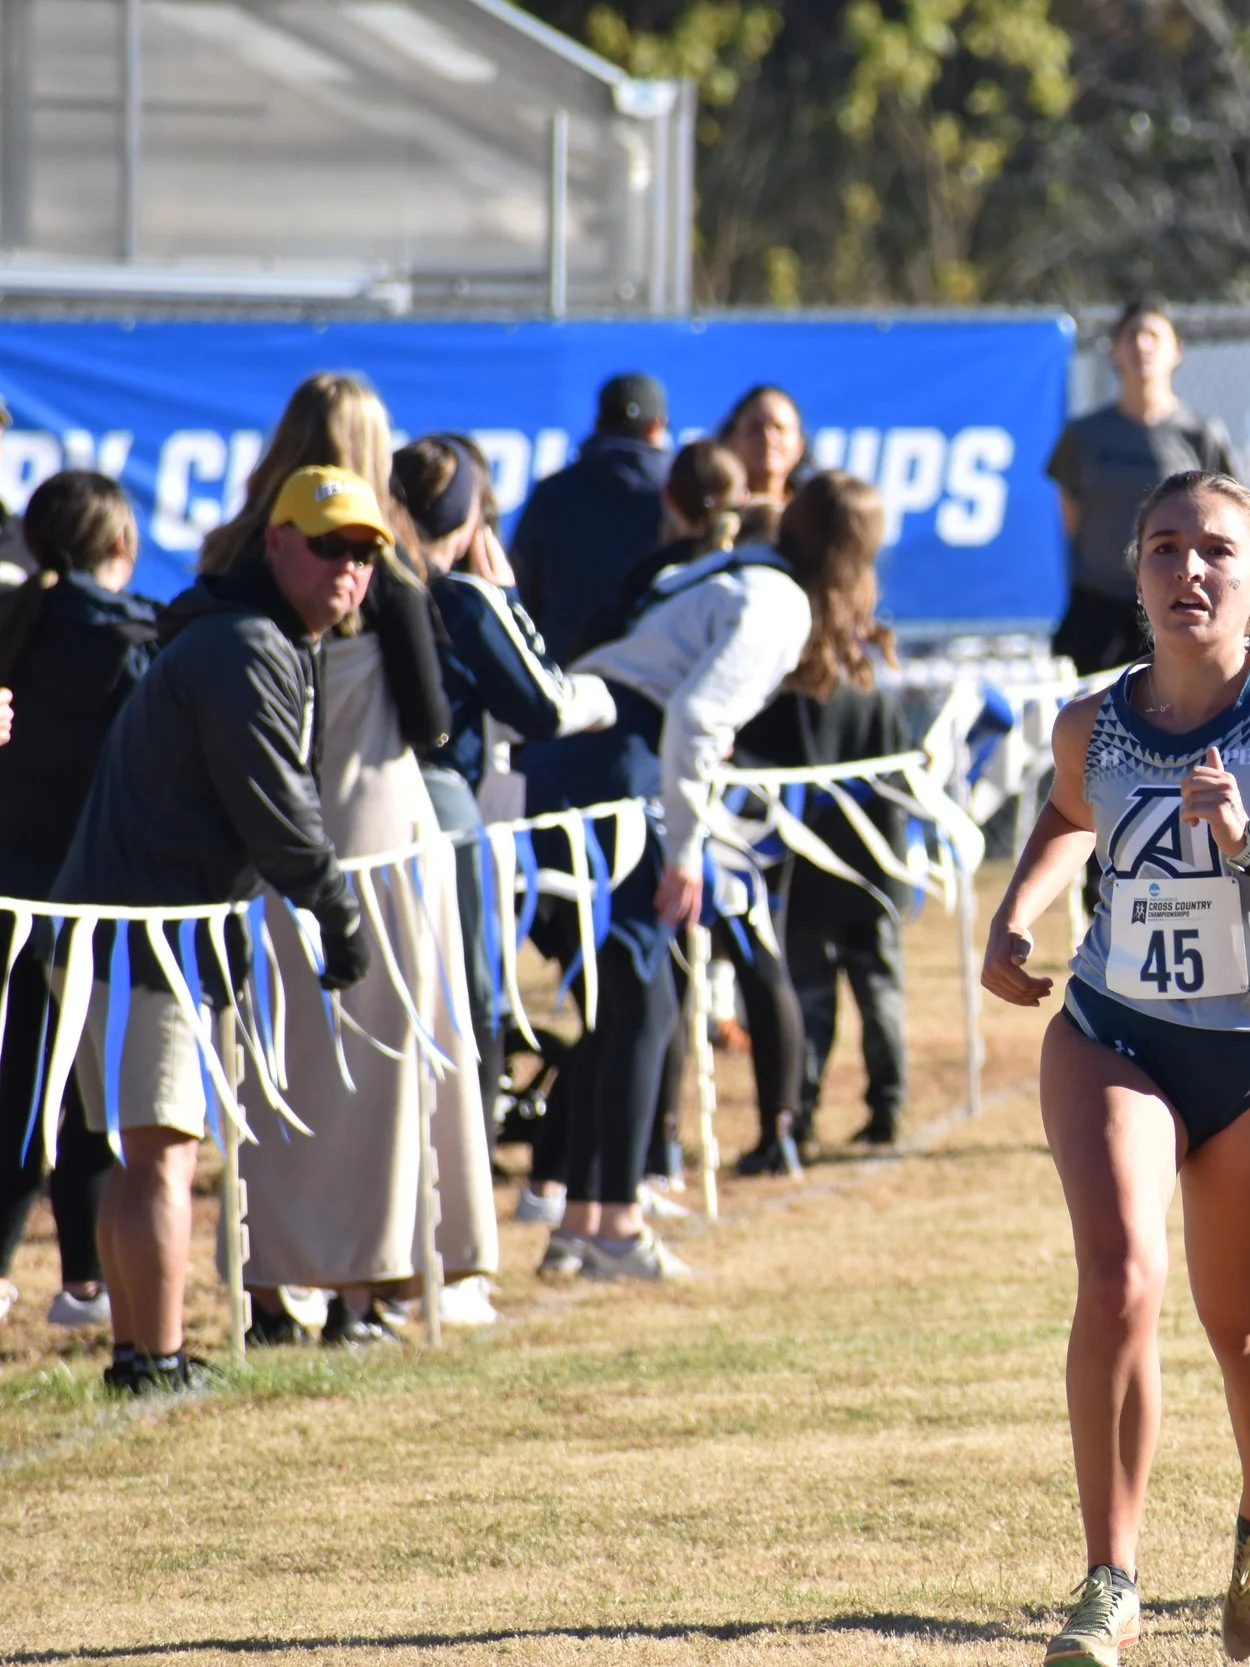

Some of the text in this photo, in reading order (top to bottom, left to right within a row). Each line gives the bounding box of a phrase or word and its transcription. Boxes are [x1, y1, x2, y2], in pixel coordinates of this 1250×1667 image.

[1148, 901, 1212, 912] CROSS COUNTRY
[1140, 929, 1205, 994] 45
